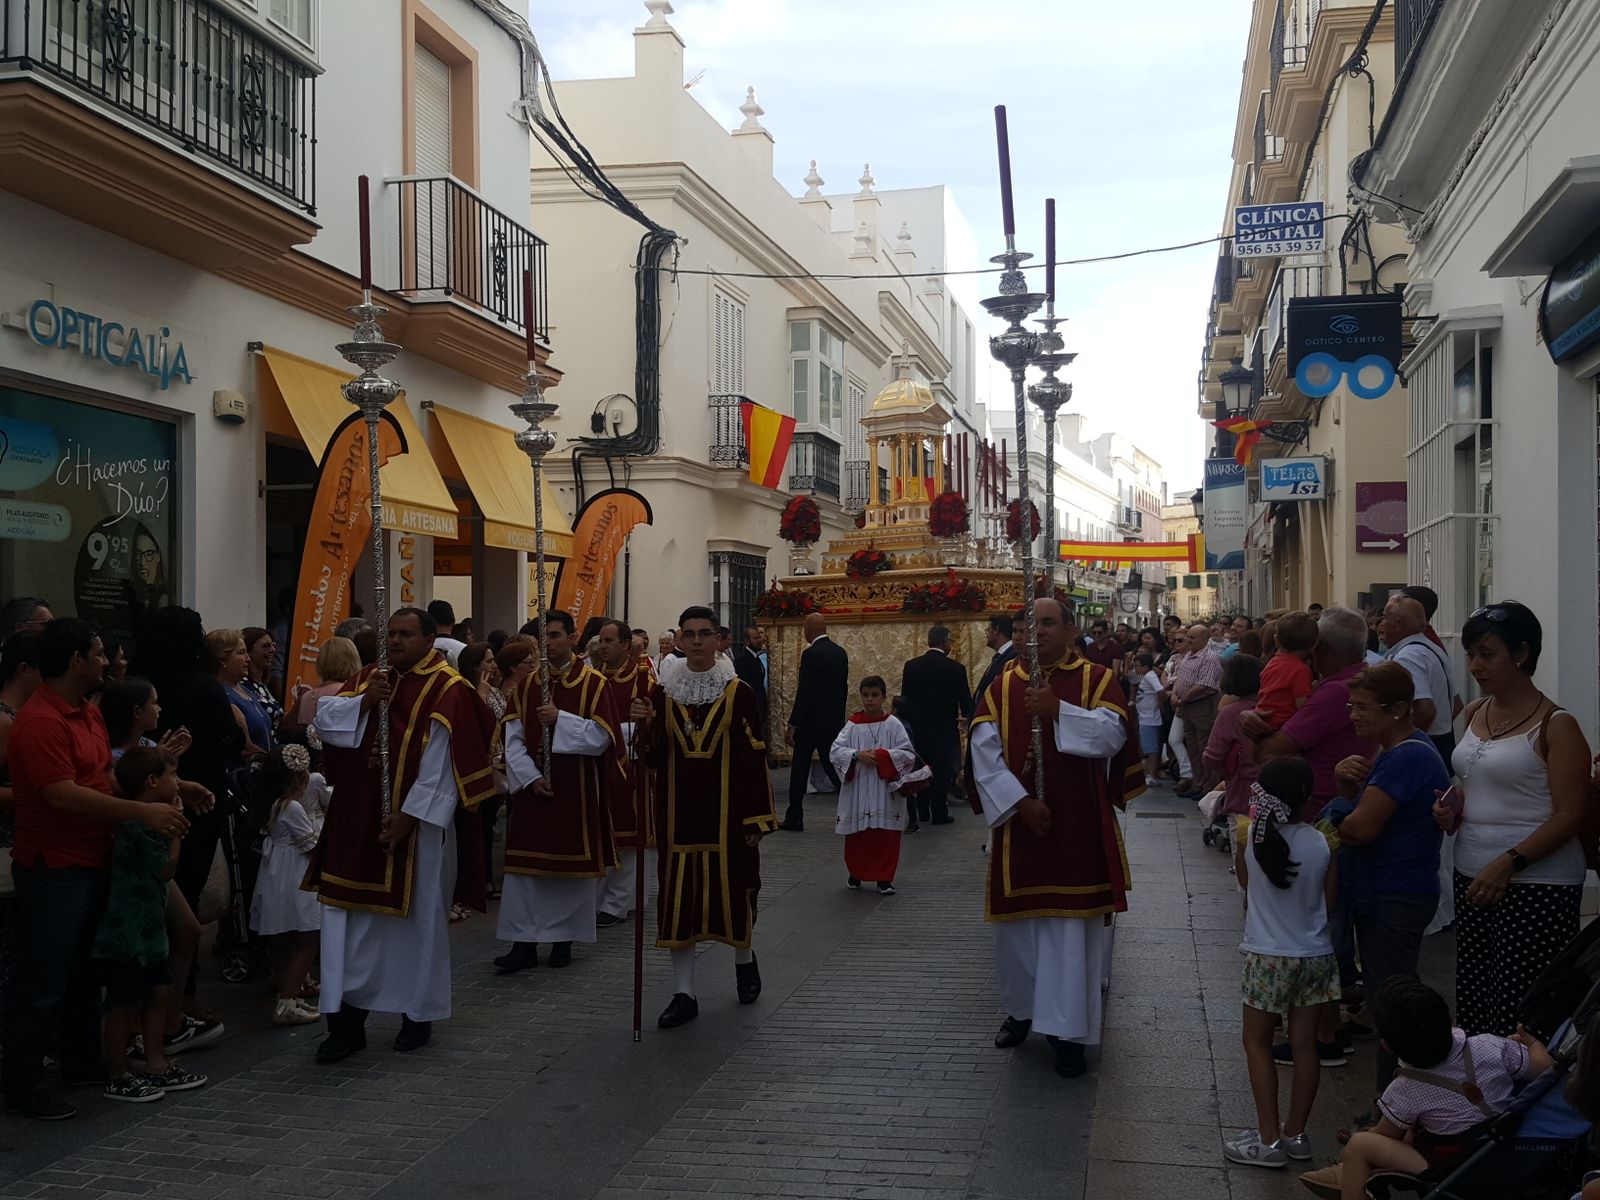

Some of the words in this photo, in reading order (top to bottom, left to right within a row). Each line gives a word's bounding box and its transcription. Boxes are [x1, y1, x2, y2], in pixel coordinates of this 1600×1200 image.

[1237, 207, 1321, 226] CLÍNICA
[1239, 224, 1320, 242] DENTAL
[1238, 245, 1261, 255] 956
[1266, 243, 1281, 253] 53
[1286, 242, 1301, 252] 39
[1306, 240, 1321, 251] 37
[56, 438, 147, 491] ¿Hacemos
[153, 458, 171, 473] un
[1270, 467, 1315, 481] TELAS
[102, 476, 169, 527] Dúo?
[402, 510, 455, 534] ARTESANA
[505, 529, 557, 553] YOGURRIA
[576, 501, 618, 586] Artesanos
[1514, 1143, 1557, 1152] MACLAREN
